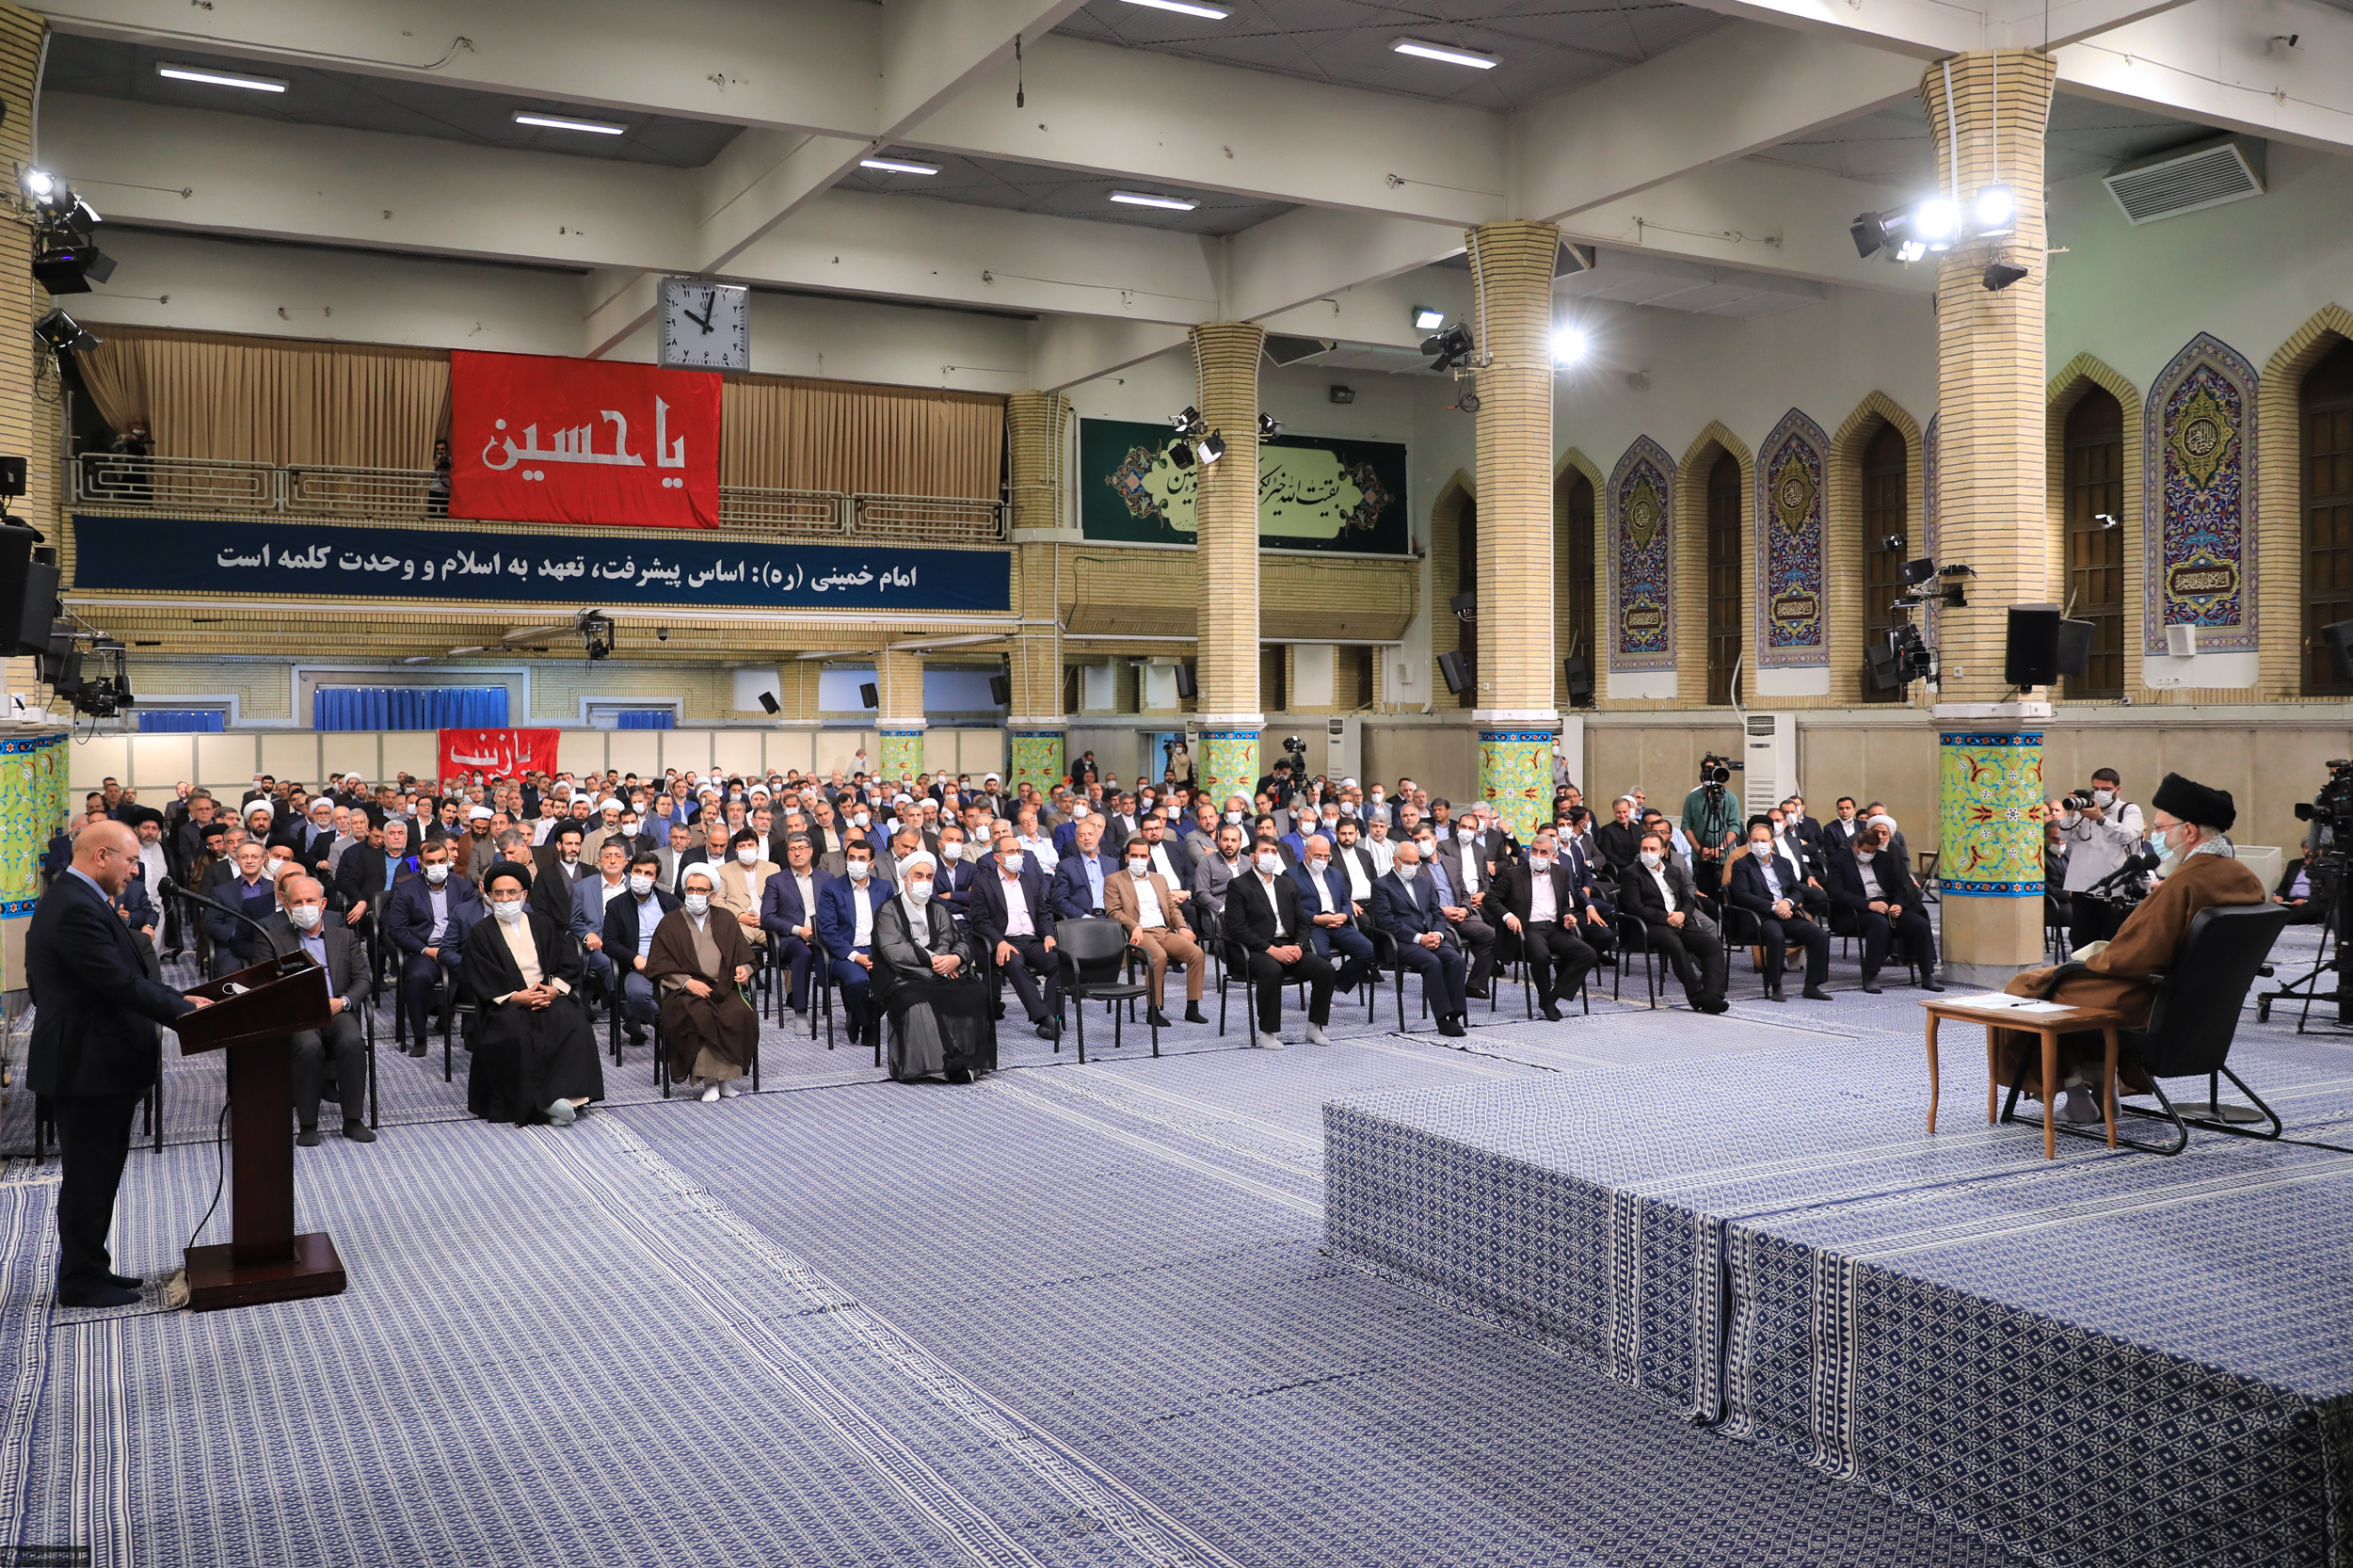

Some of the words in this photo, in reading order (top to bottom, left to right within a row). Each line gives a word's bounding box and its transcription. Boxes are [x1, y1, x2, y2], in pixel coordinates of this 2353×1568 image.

[482, 409, 647, 482] حسین
[655, 394, 685, 488] یا
[216, 543, 270, 568] است
[278, 544, 331, 569] کلمه
[338, 552, 415, 581] وحدت
[441, 550, 501, 582] اسلام
[537, 555, 585, 582] تعهد
[421, 560, 435, 581] و
[507, 557, 528, 583] به
[687, 559, 745, 588] اساس
[810, 564, 874, 592] خمینی
[879, 566, 917, 593] امام
